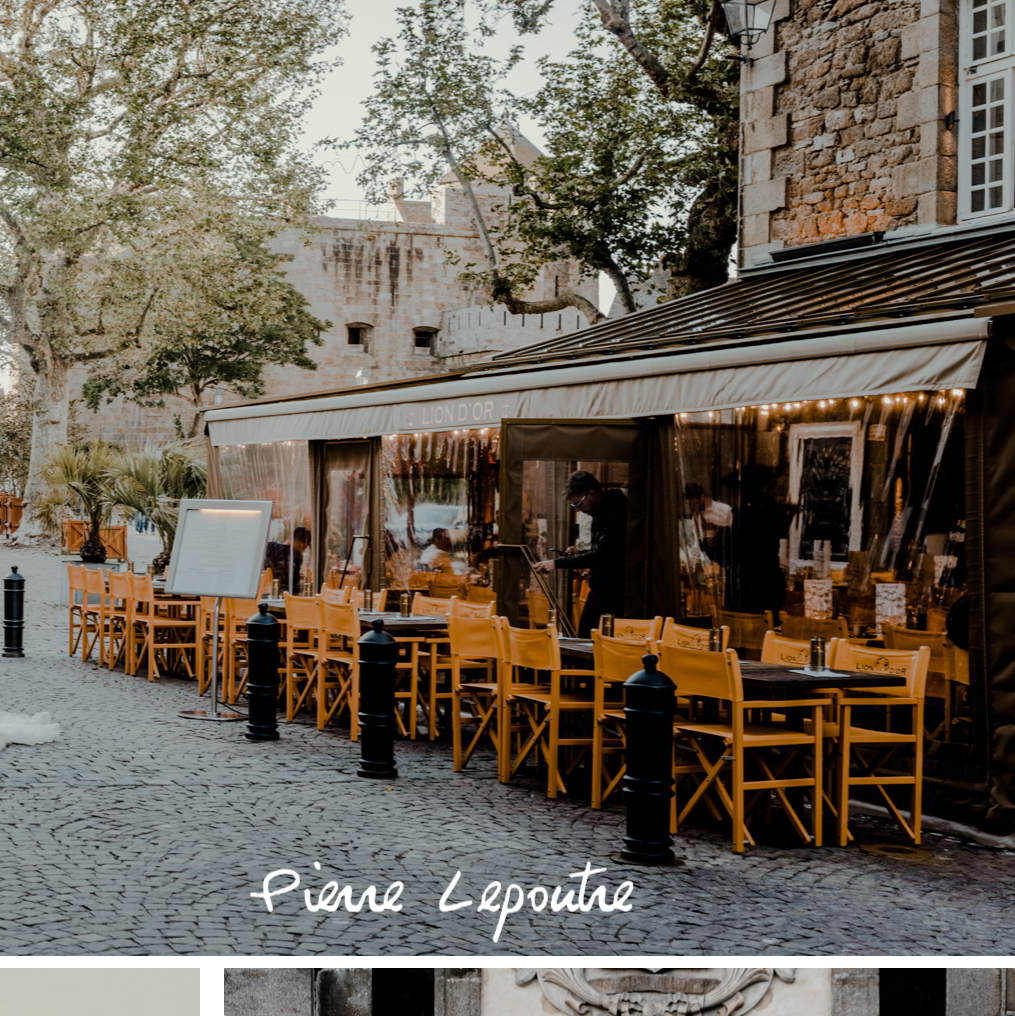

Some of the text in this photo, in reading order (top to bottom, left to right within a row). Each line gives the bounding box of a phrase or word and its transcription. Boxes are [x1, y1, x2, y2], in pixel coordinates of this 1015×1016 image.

[422, 400, 494, 425] LION D'OR
[780, 653, 797, 662] LION
[856, 662, 907, 675] LION D'OR
